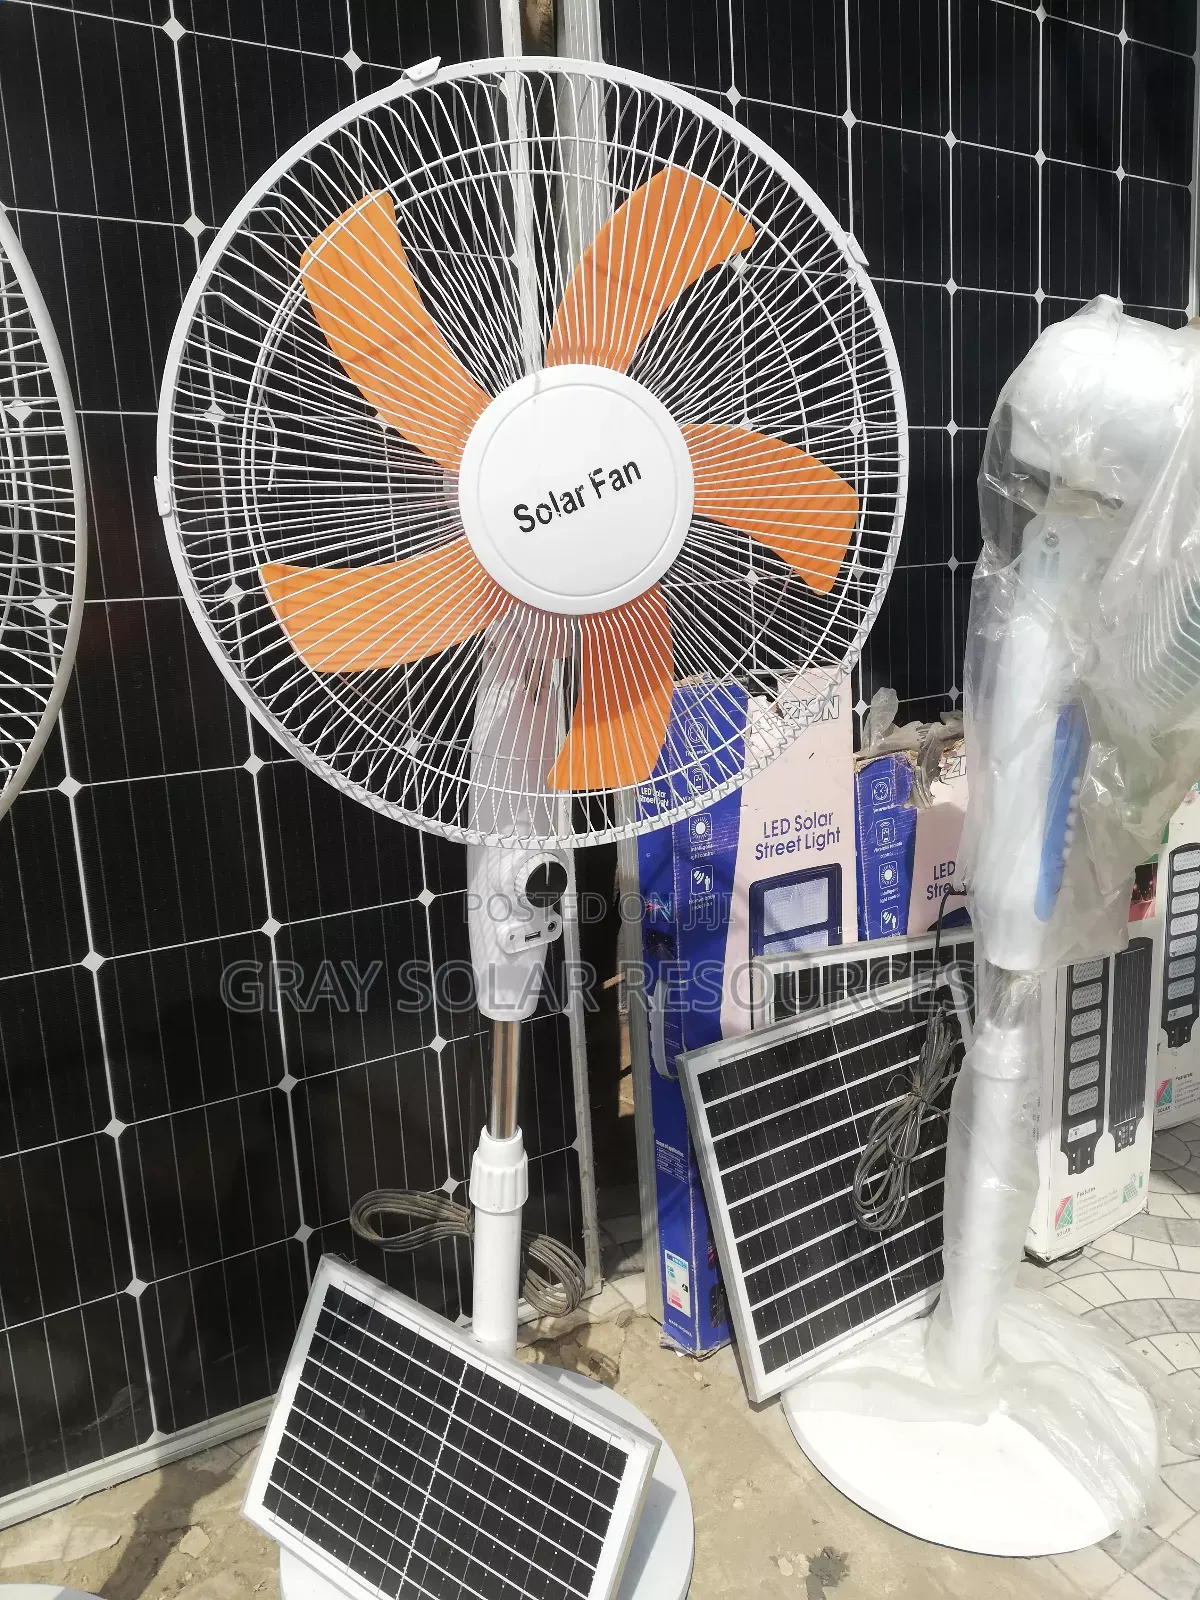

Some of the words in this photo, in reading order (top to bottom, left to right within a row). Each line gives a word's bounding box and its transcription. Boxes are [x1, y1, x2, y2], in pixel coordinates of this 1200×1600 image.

[513, 485, 586, 533] Solar
[588, 461, 642, 499] Fan
[763, 818, 791, 838] LED
[794, 811, 834, 832] Solar
[755, 835, 802, 861] Street
[805, 826, 841, 851] Light
[933, 861, 956, 881] LED
[926, 882, 952, 901] Stre
